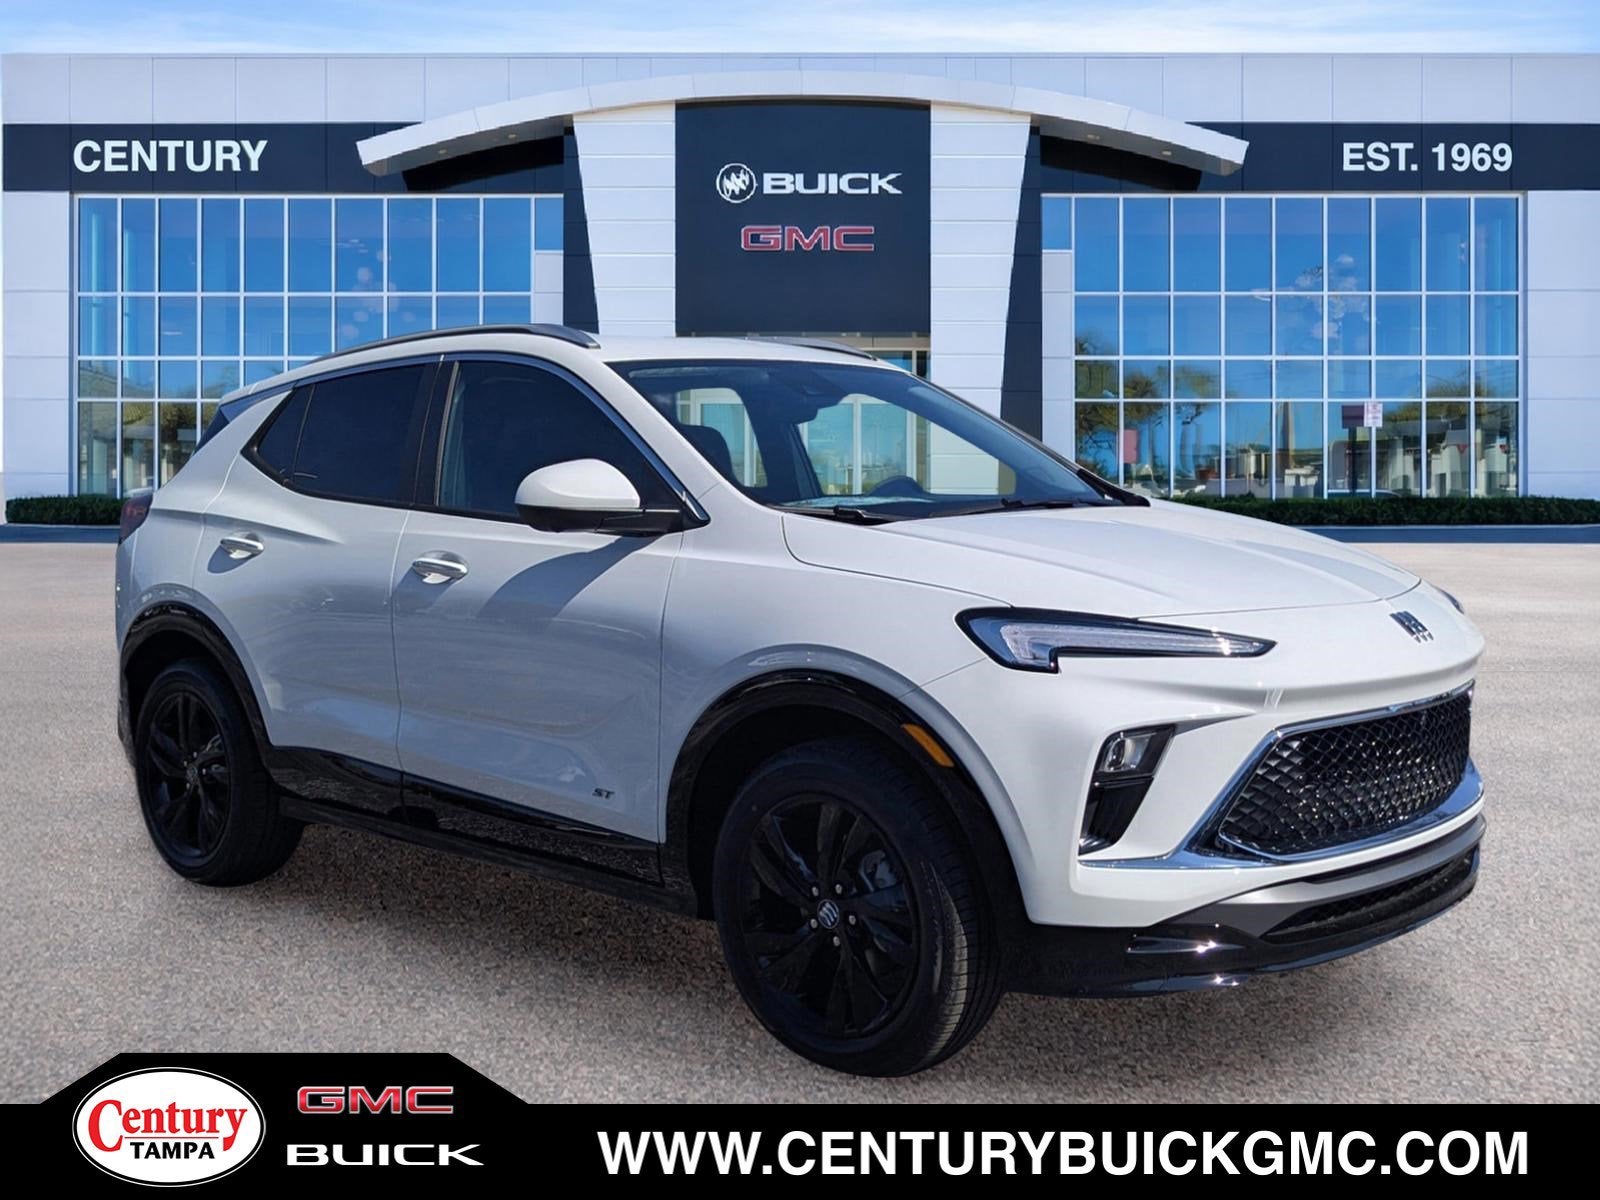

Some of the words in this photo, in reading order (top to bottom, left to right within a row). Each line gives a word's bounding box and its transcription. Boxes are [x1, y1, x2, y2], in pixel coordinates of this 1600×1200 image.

[73, 139, 268, 173] CENTURY
[1342, 141, 1419, 172] EST.
[1431, 142, 1513, 172] 1969
[762, 172, 903, 195] BUICK
[740, 224, 875, 251] GMC
[592, 787, 615, 800] ST
